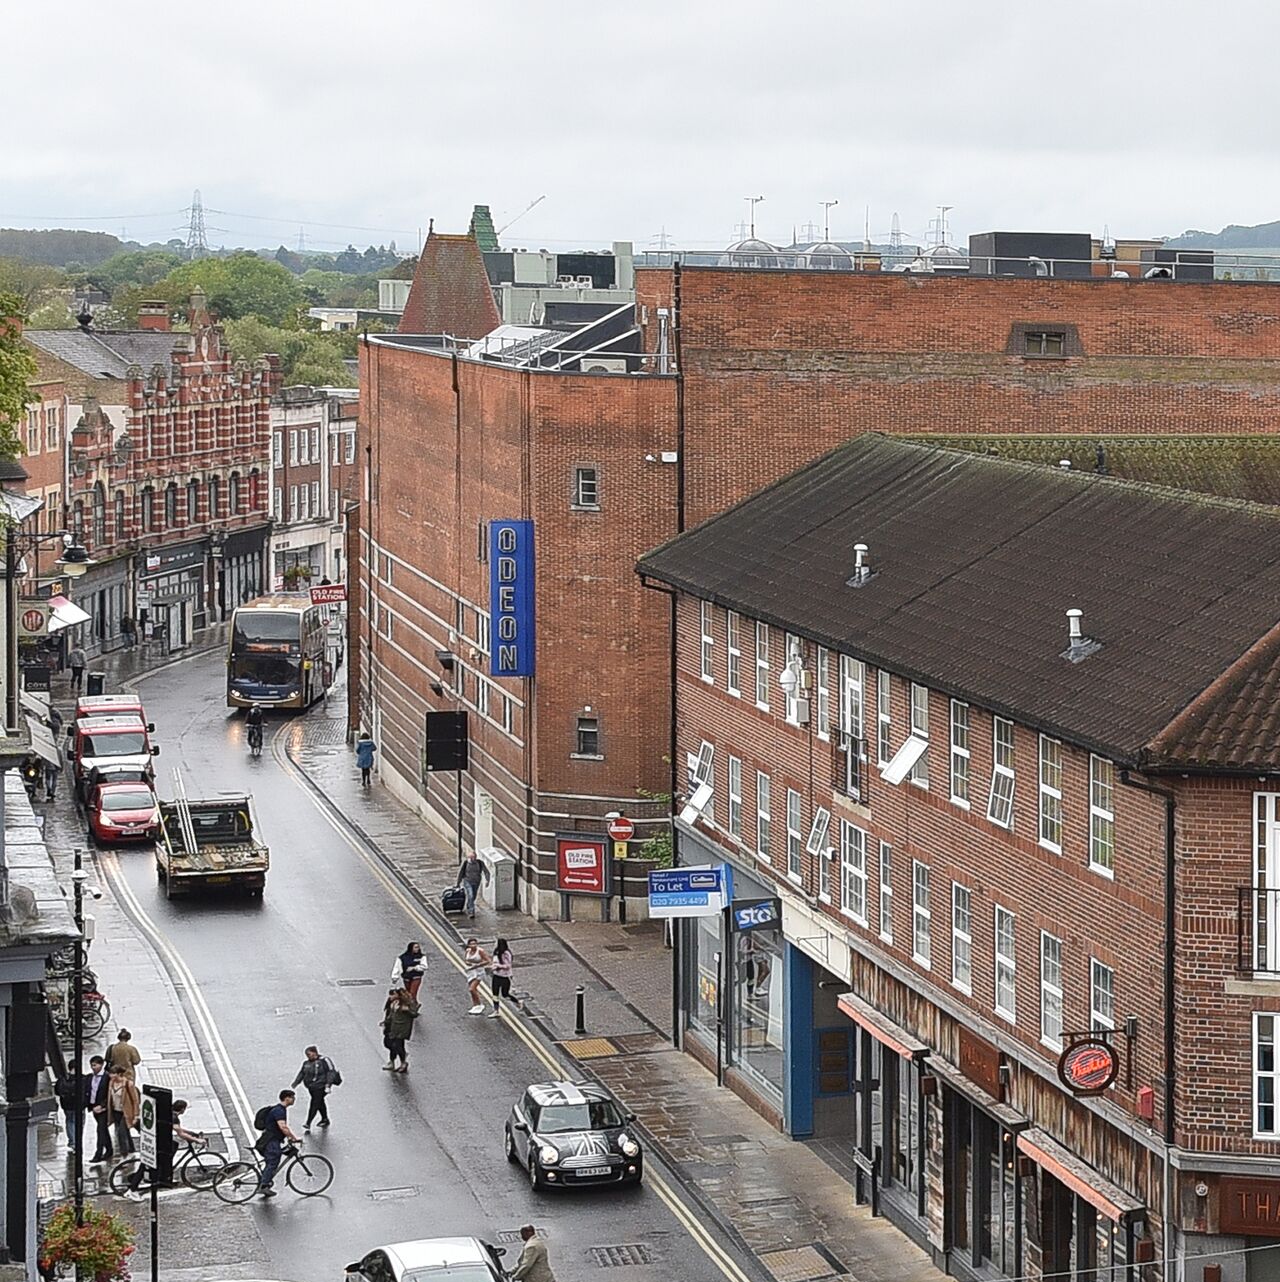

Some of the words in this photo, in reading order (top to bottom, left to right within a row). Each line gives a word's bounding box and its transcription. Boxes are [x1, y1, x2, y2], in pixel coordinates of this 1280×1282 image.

[498, 527, 518, 671] ODEON
[569, 857, 594, 865] STATION
[652, 883, 665, 891] To
[667, 882, 683, 891] Let
